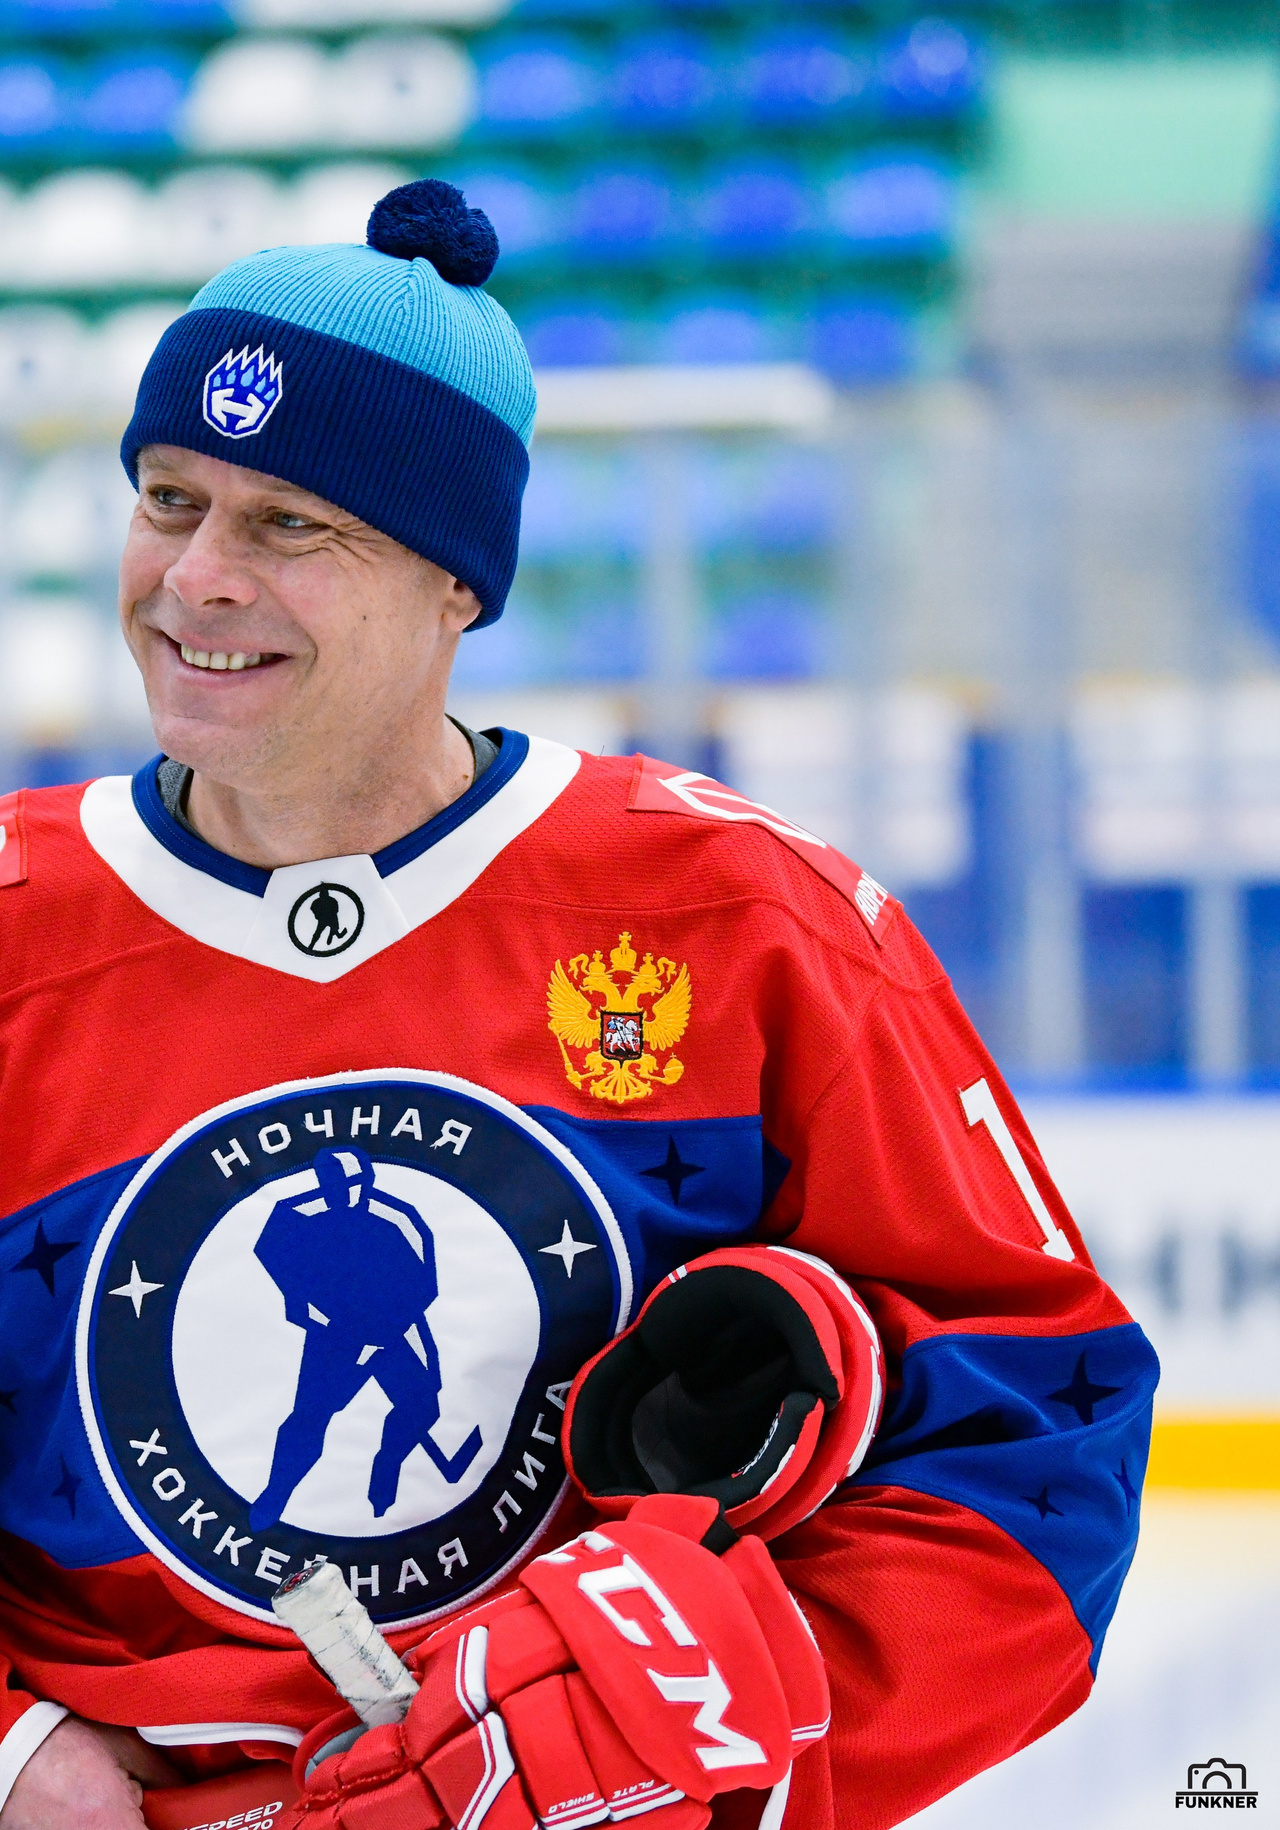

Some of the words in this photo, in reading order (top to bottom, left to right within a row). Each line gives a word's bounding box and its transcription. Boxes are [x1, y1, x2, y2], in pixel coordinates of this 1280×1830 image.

[210, 1104, 474, 1179] НОЧНАЯ
[959, 1077, 1076, 1263] 1
[128, 1427, 470, 1599] ХОККЕНАЯ
[491, 1379, 574, 1534] ЛИГА
[547, 1791, 595, 1815] SHIELD
[612, 1779, 655, 1800] PLATE
[237, 1818, 274, 1830] 70
